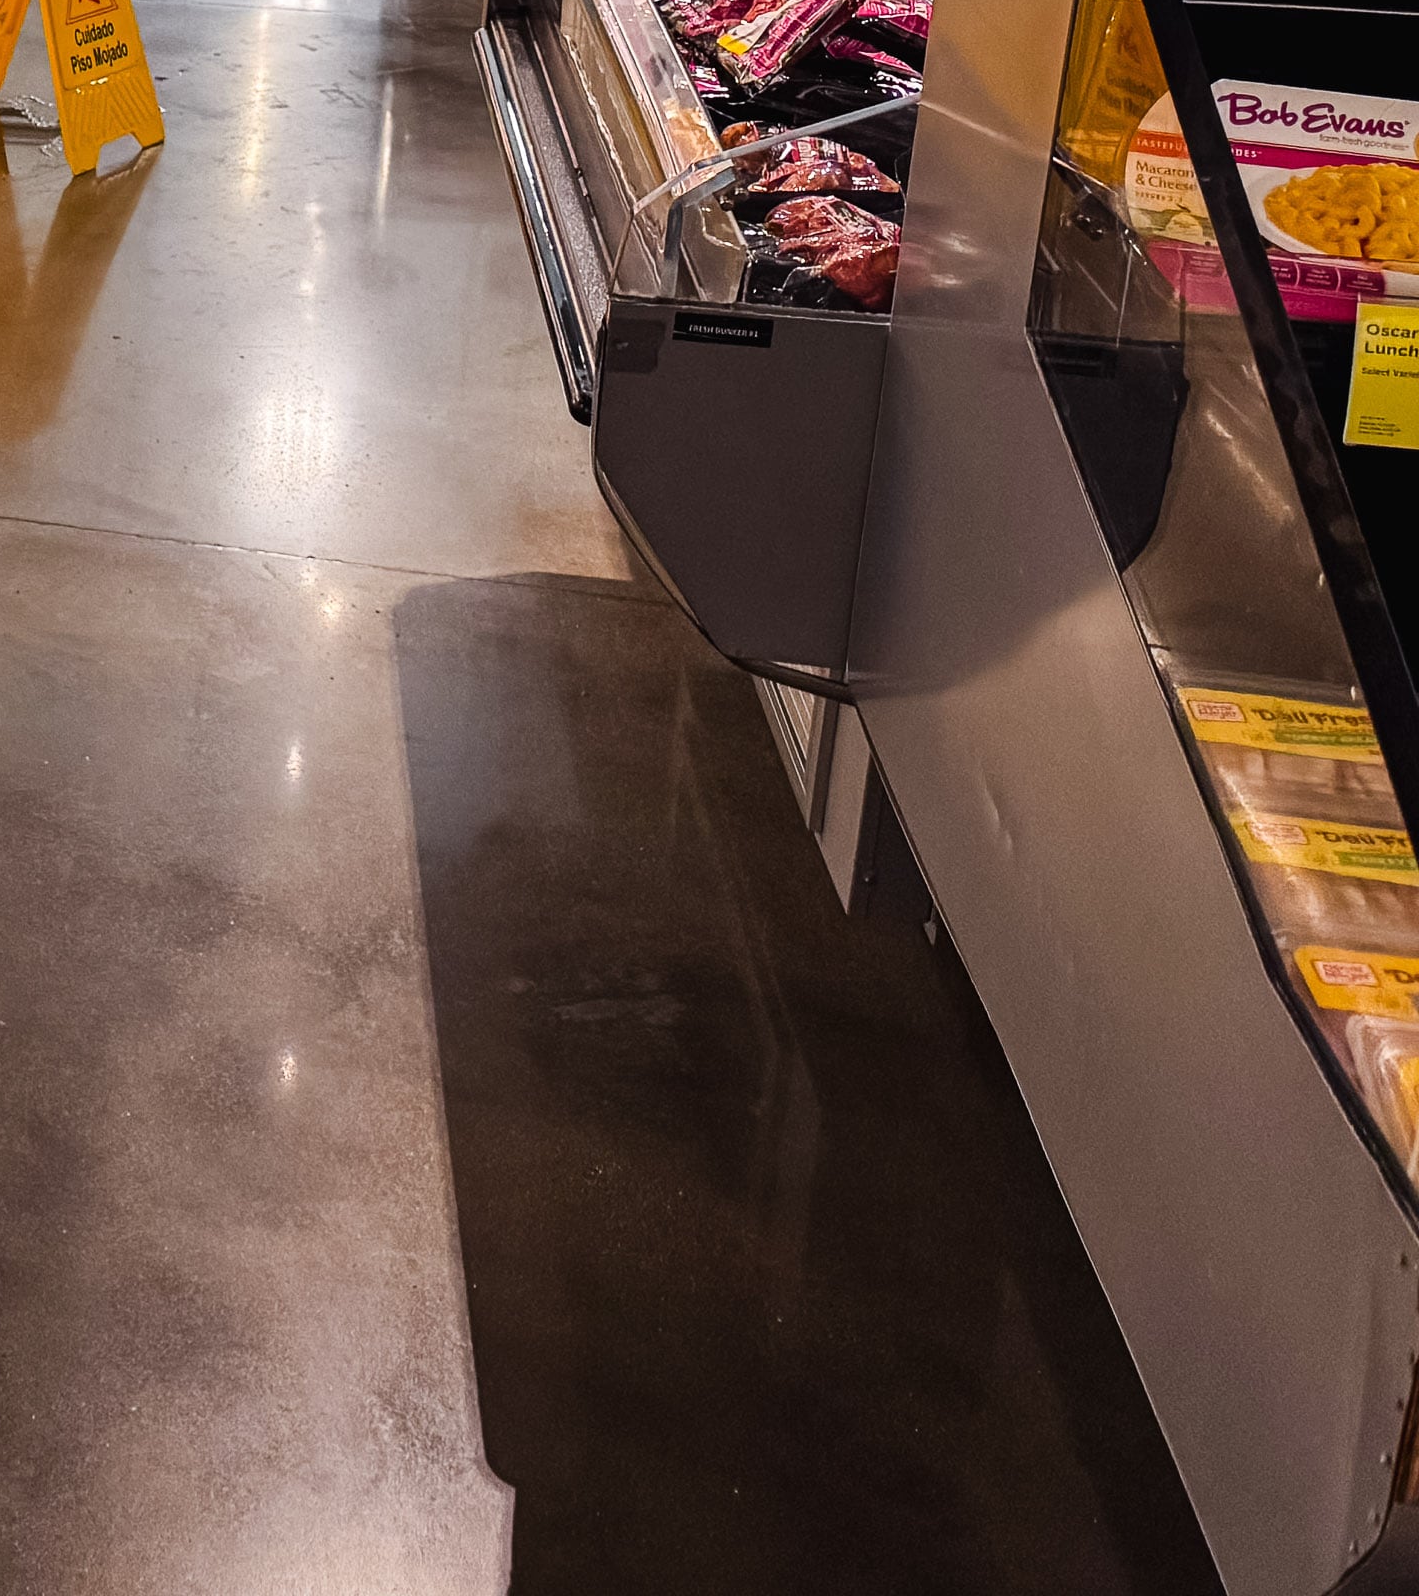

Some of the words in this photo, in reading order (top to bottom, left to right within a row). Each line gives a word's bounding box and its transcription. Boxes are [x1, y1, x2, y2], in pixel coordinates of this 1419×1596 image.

[74, 20, 115, 47] Cuidado
[70, 53, 93, 75] Piso
[94, 39, 129, 68] Mojado
[1219, 91, 1299, 130] Bob
[1302, 104, 1412, 138] Evans
[1365, 321, 1419, 341] Oscar
